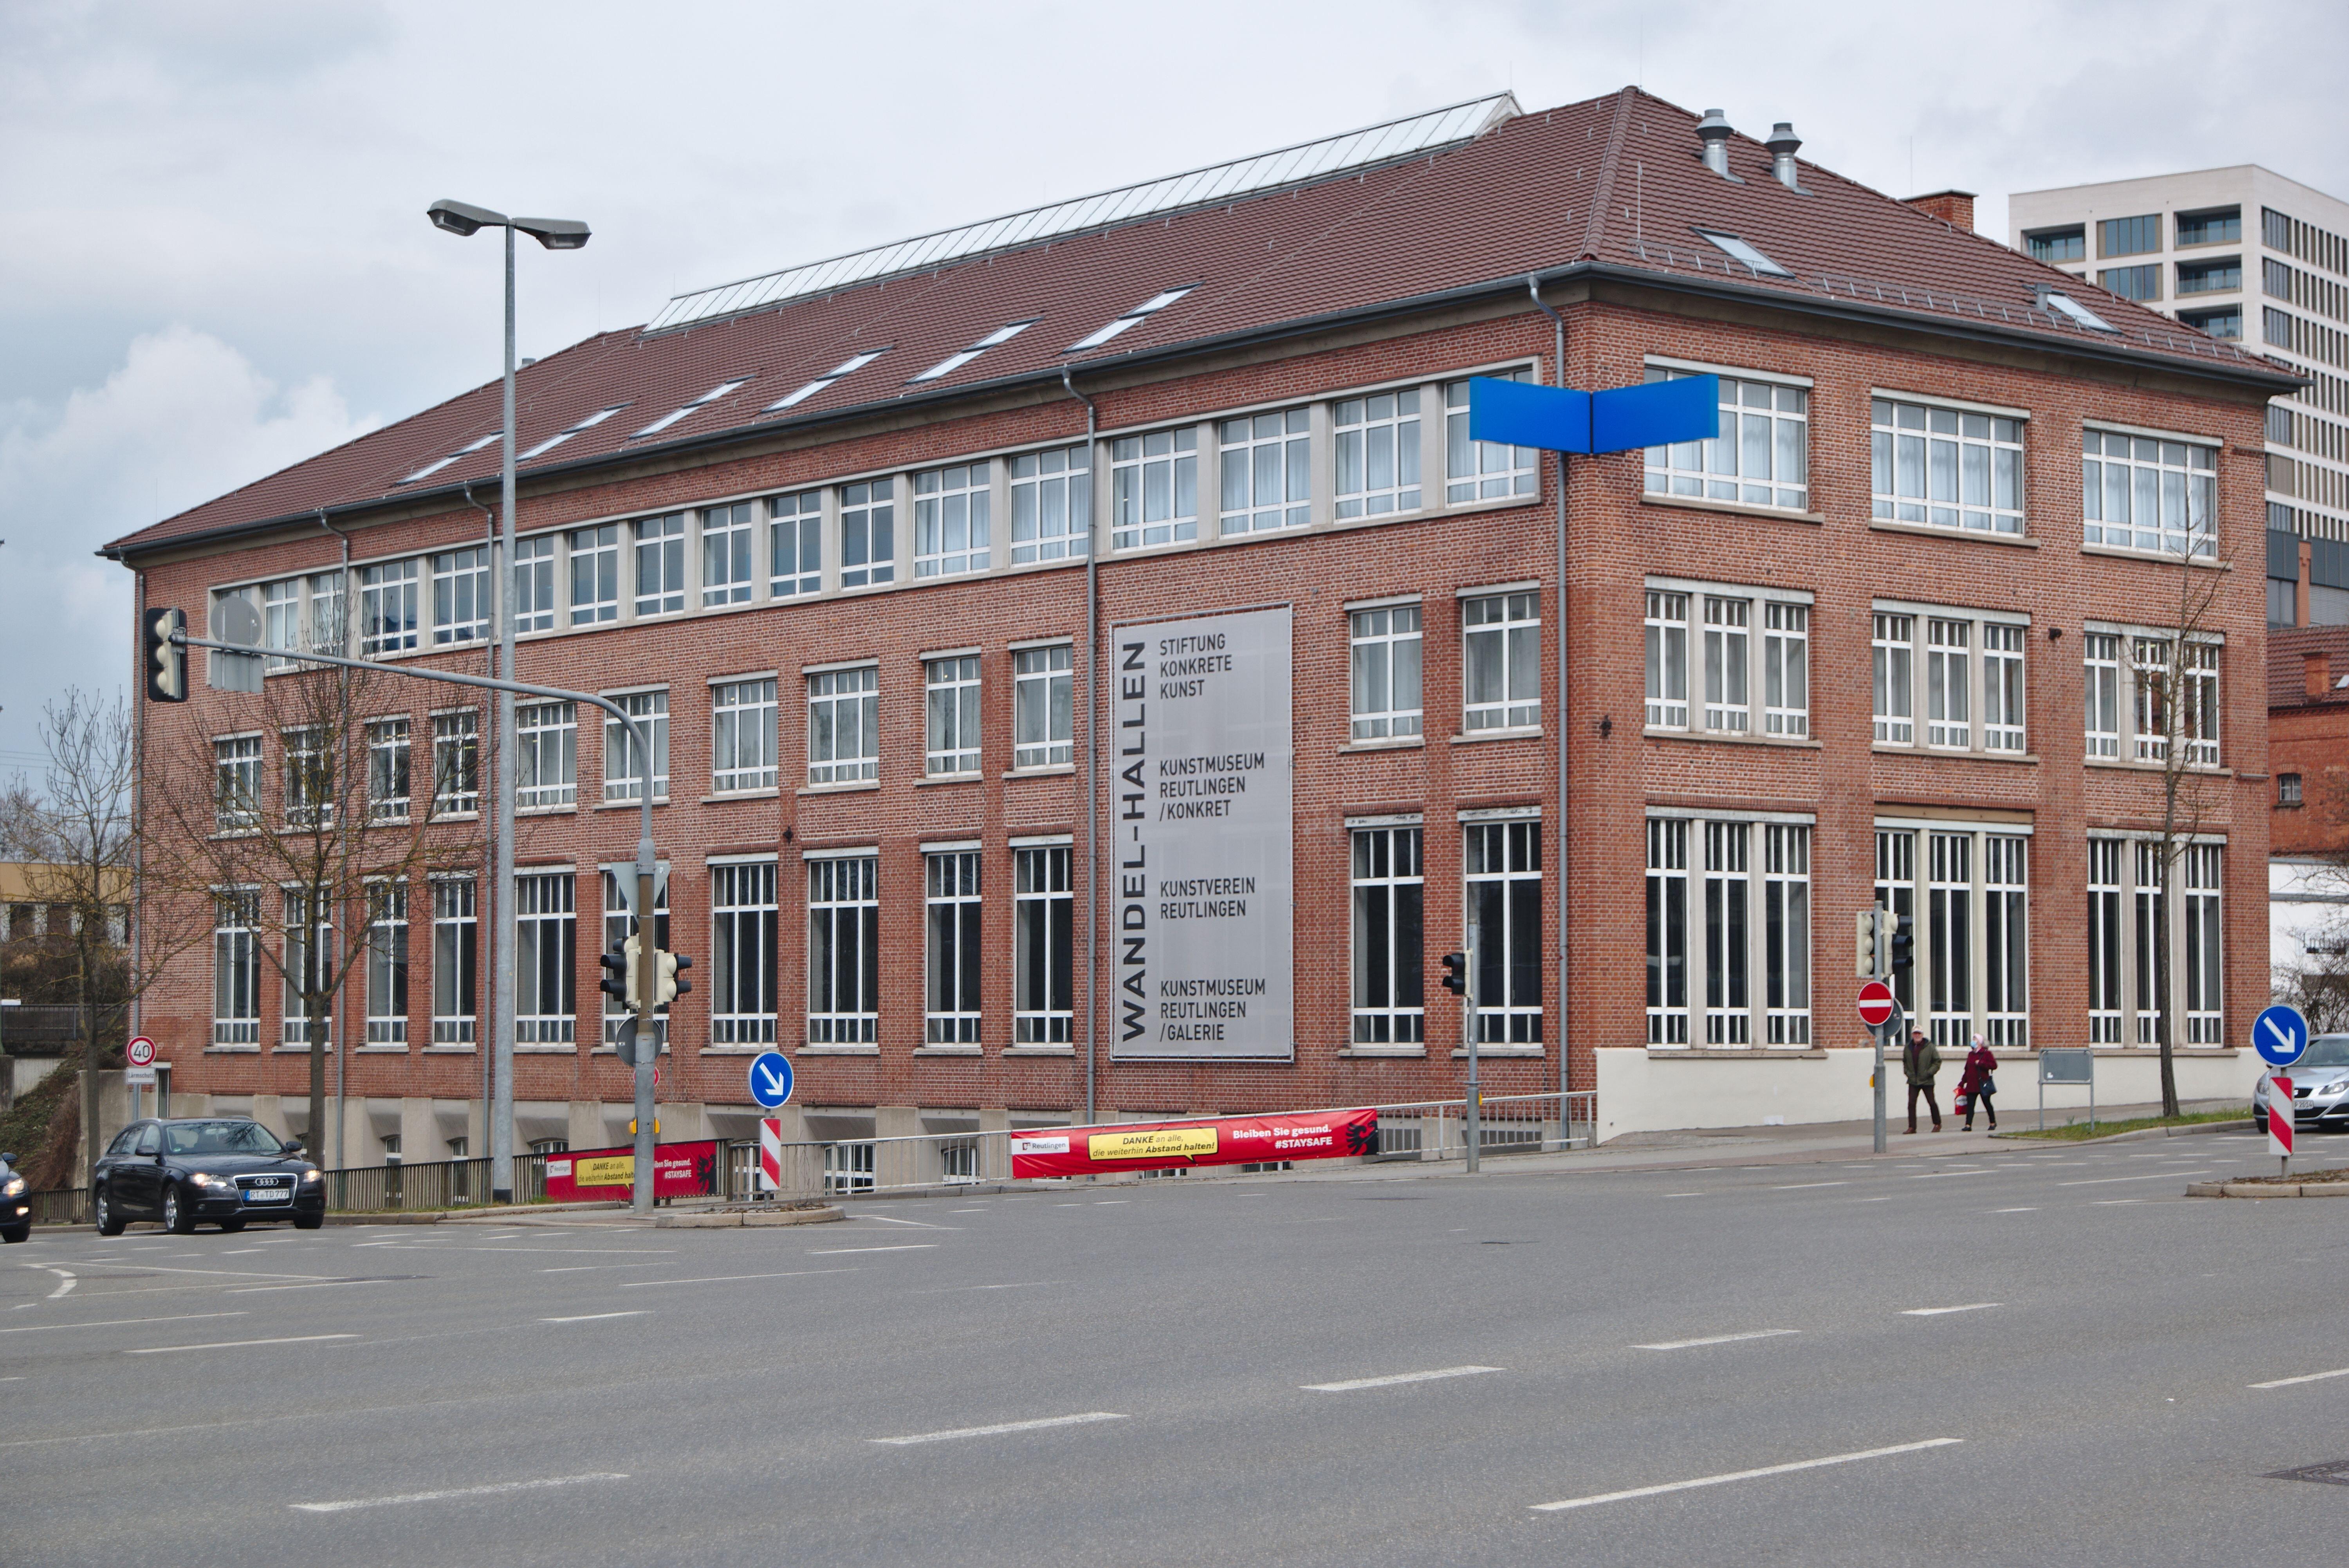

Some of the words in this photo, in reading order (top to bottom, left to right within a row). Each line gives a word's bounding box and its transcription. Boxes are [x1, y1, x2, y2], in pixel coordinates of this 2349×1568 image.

[1160, 633, 1225, 656] STIFTUNG
[1160, 654, 1232, 677] KONKRETE
[1160, 679, 1205, 699] KUNST
[1160, 752, 1265, 776] KUNSTMUSEUM
[1160, 776, 1245, 798] REUTLINGEN
[1159, 799, 1231, 821] /KONKRET
[1122, 642, 1146, 1042] WANDEL-HALLEN
[1161, 877, 1255, 897] KUNSTVEREIN
[1161, 900, 1246, 919] REUTLINGEN
[1161, 978, 1265, 997] KUNSTMUSEUM
[1161, 1001, 1246, 1018] REUTLINGEN
[1160, 1023, 1224, 1042] /GALERIE
[134, 1045, 150, 1058] 40
[1123, 1136, 1153, 1145] DANKE
[1167, 1135, 1184, 1143] alle,
[1233, 1130, 1271, 1139] Bleiben
[1274, 1128, 1290, 1136] Sie
[1292, 1124, 1332, 1137] gesund.
[1107, 1147, 1143, 1155] weiterhin
[1146, 1144, 1181, 1153] Abstand
[1184, 1142, 1214, 1151] halten!
[1275, 1137, 1333, 1149] #STAYSAFE
[593, 1162, 609, 1171] DANKE
[673, 1158, 691, 1169] gesund.
[604, 1172, 624, 1180] Abstand
[665, 1169, 692, 1179] #STAYSAFE
